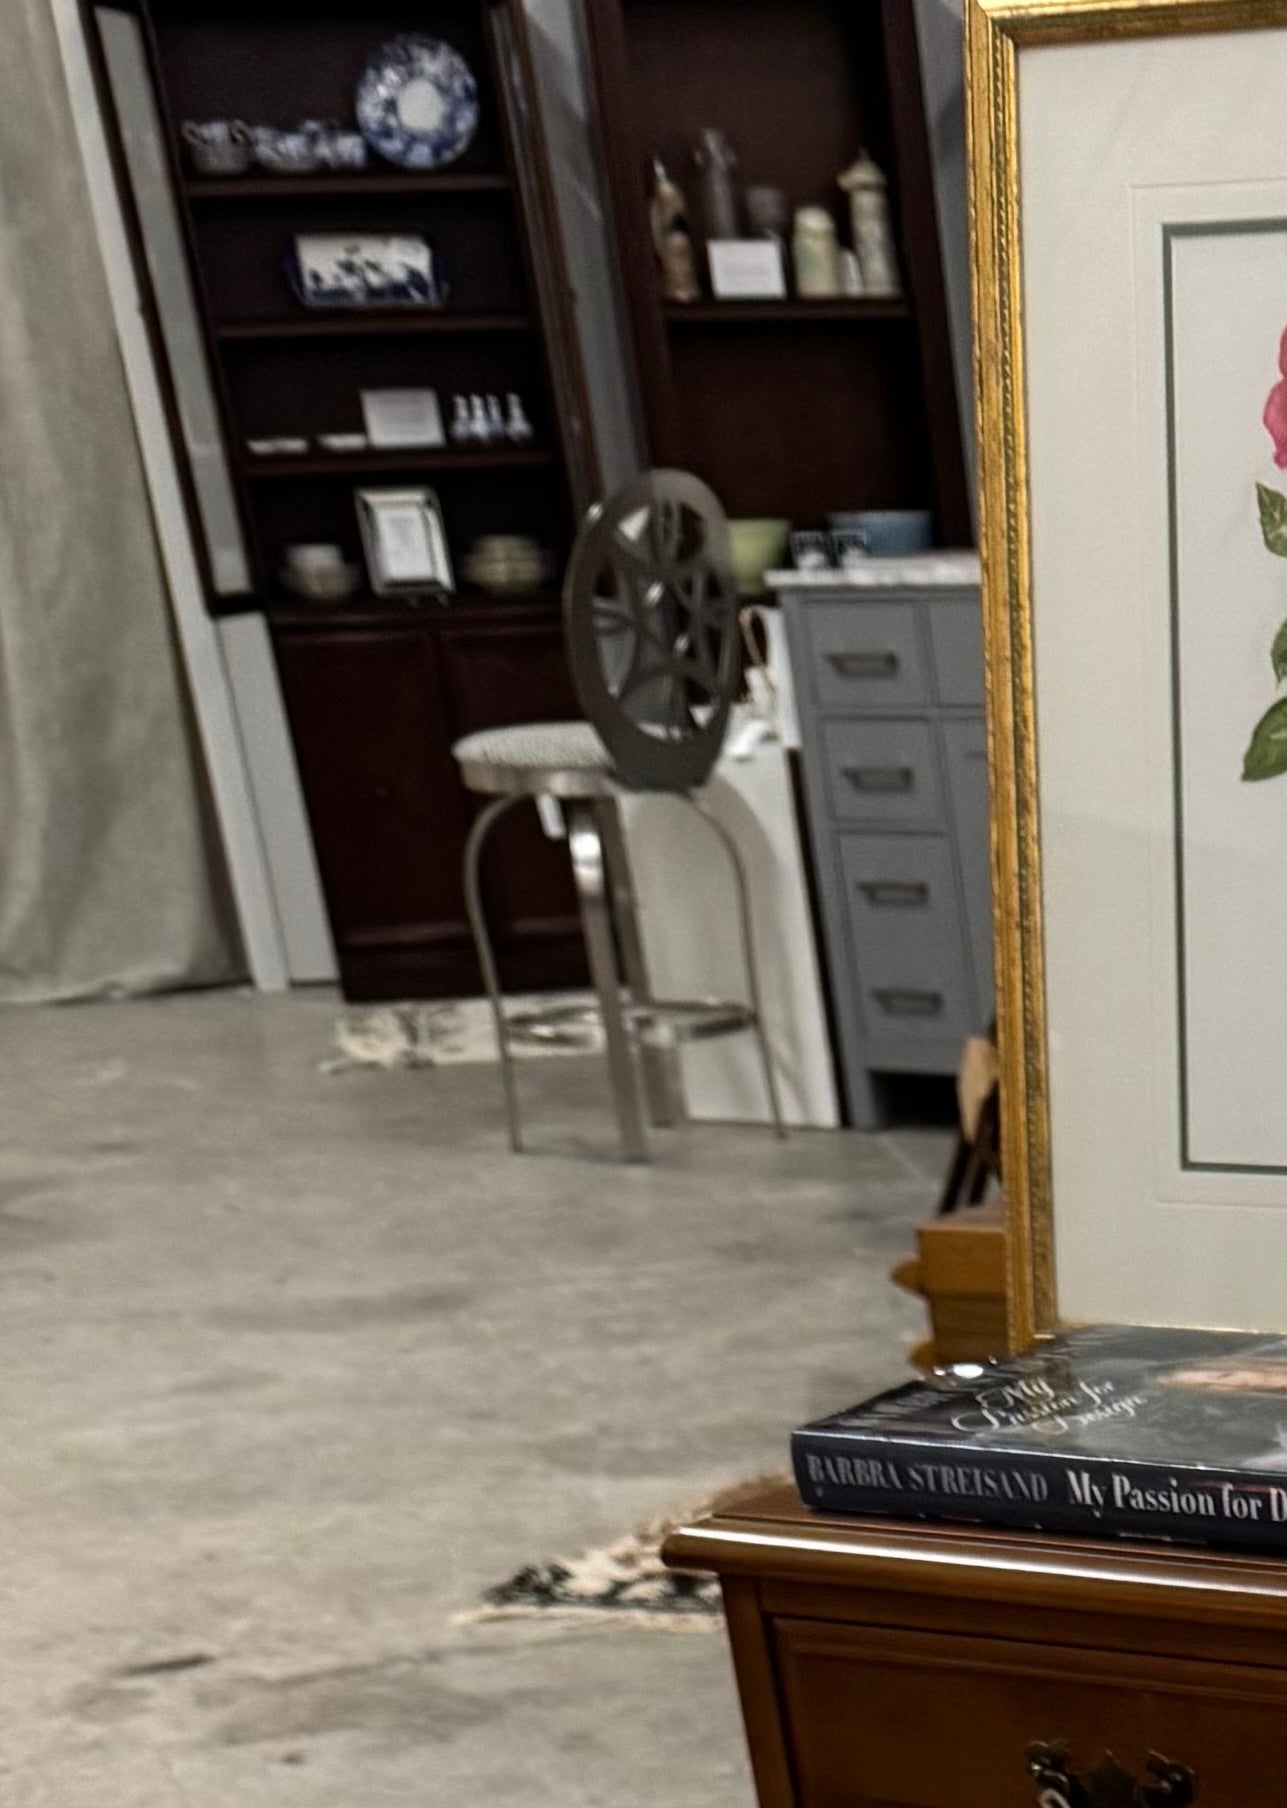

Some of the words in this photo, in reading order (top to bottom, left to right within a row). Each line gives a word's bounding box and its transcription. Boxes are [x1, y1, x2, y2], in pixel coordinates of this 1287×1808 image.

[806, 1454, 902, 1490] BARBRA
[908, 1464, 1048, 1502] STREISAND
[1066, 1469, 1107, 1518] My
[1111, 1474, 1216, 1517] Passion
[1222, 1482, 1263, 1521] for
